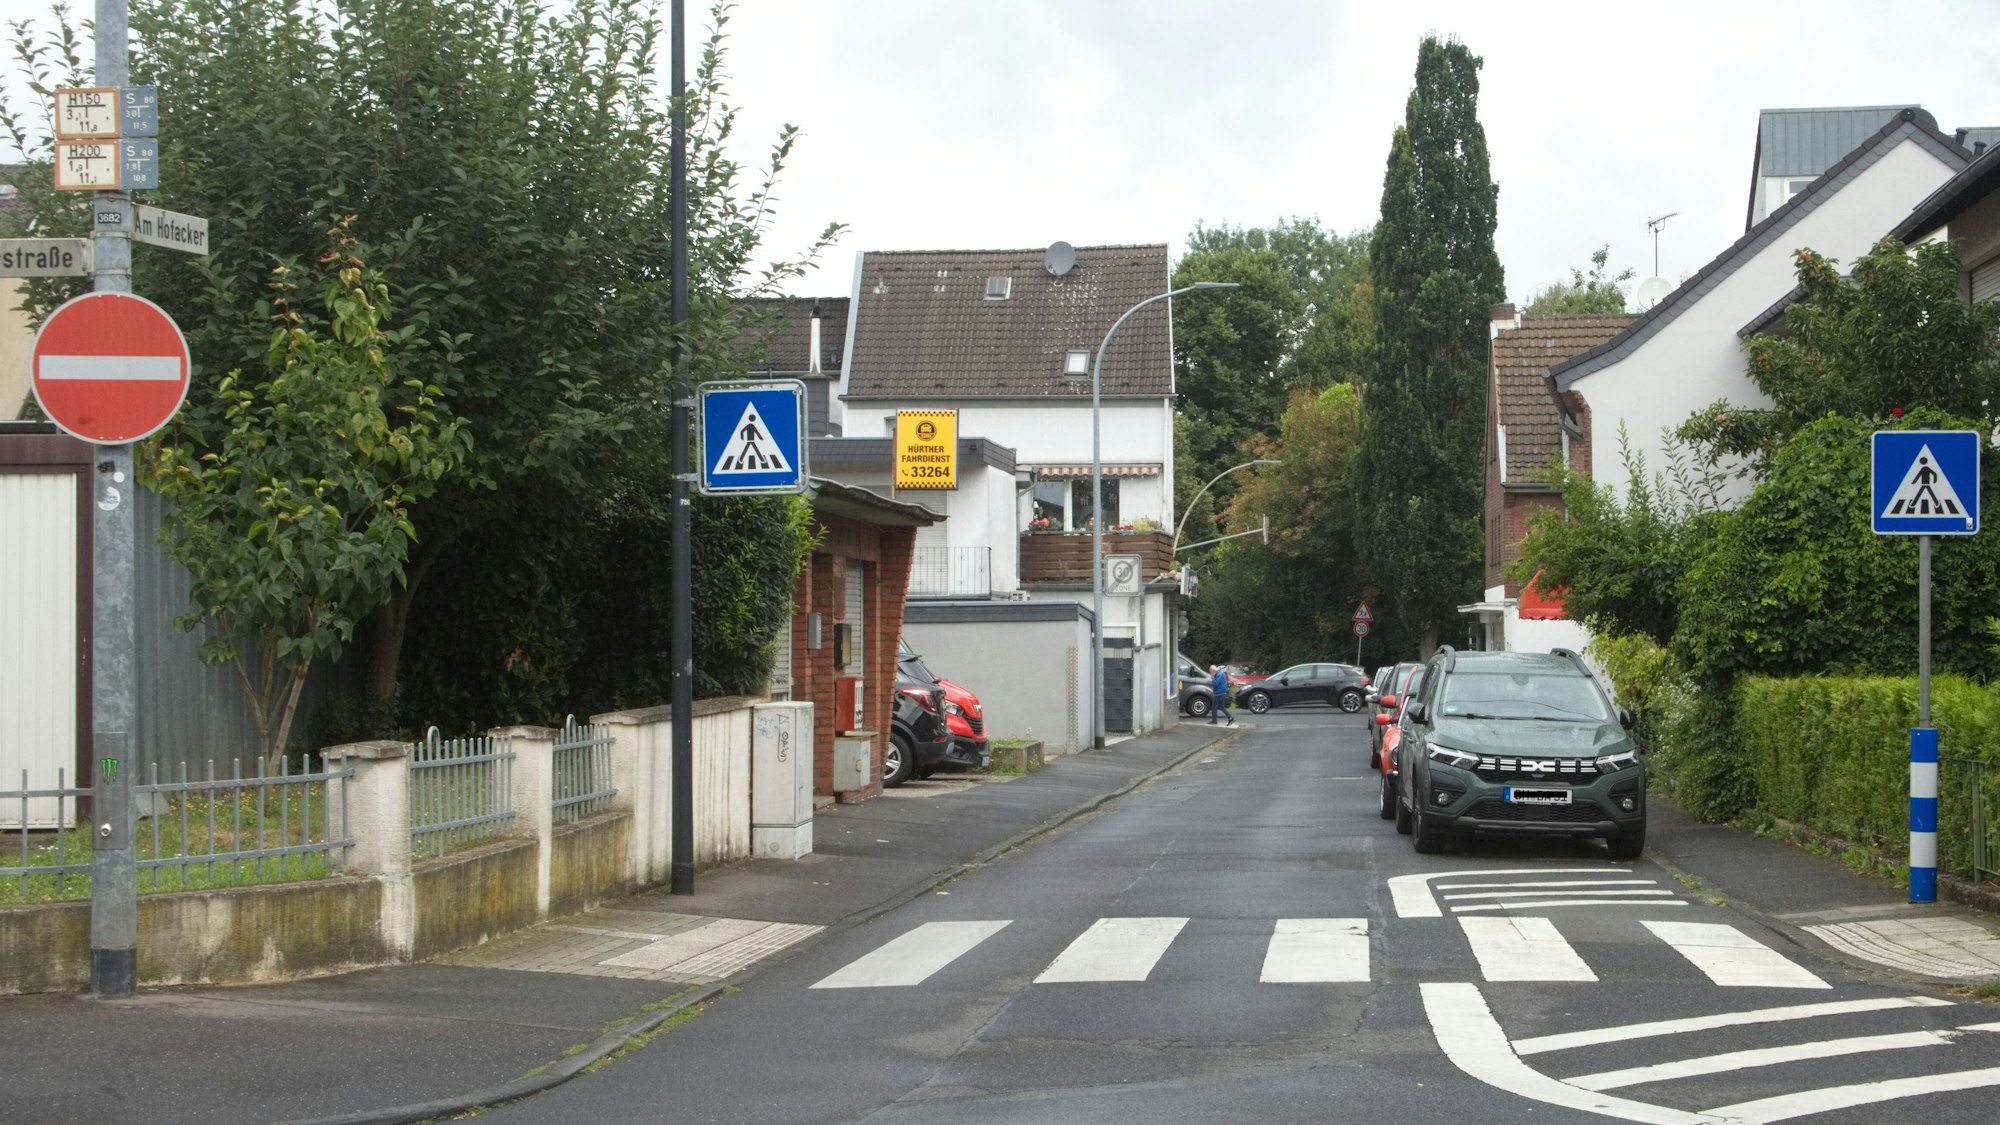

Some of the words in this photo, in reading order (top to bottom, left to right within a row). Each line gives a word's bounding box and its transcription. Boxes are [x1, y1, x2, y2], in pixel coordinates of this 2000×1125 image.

[69, 93, 101, 105] H150
[126, 92, 135, 104] S
[69, 145, 101, 157] H200
[126, 145, 135, 157] S
[98, 213, 120, 223] 3682
[134, 211, 152, 236] Am
[157, 216, 205, 246] Hofacker
[0, 246, 73, 269] straße
[908, 444, 944, 453] HÜRTHER
[901, 455, 950, 463] FAHRDIENST
[911, 466, 950, 478] 33264
[1117, 567, 1129, 577] 30
